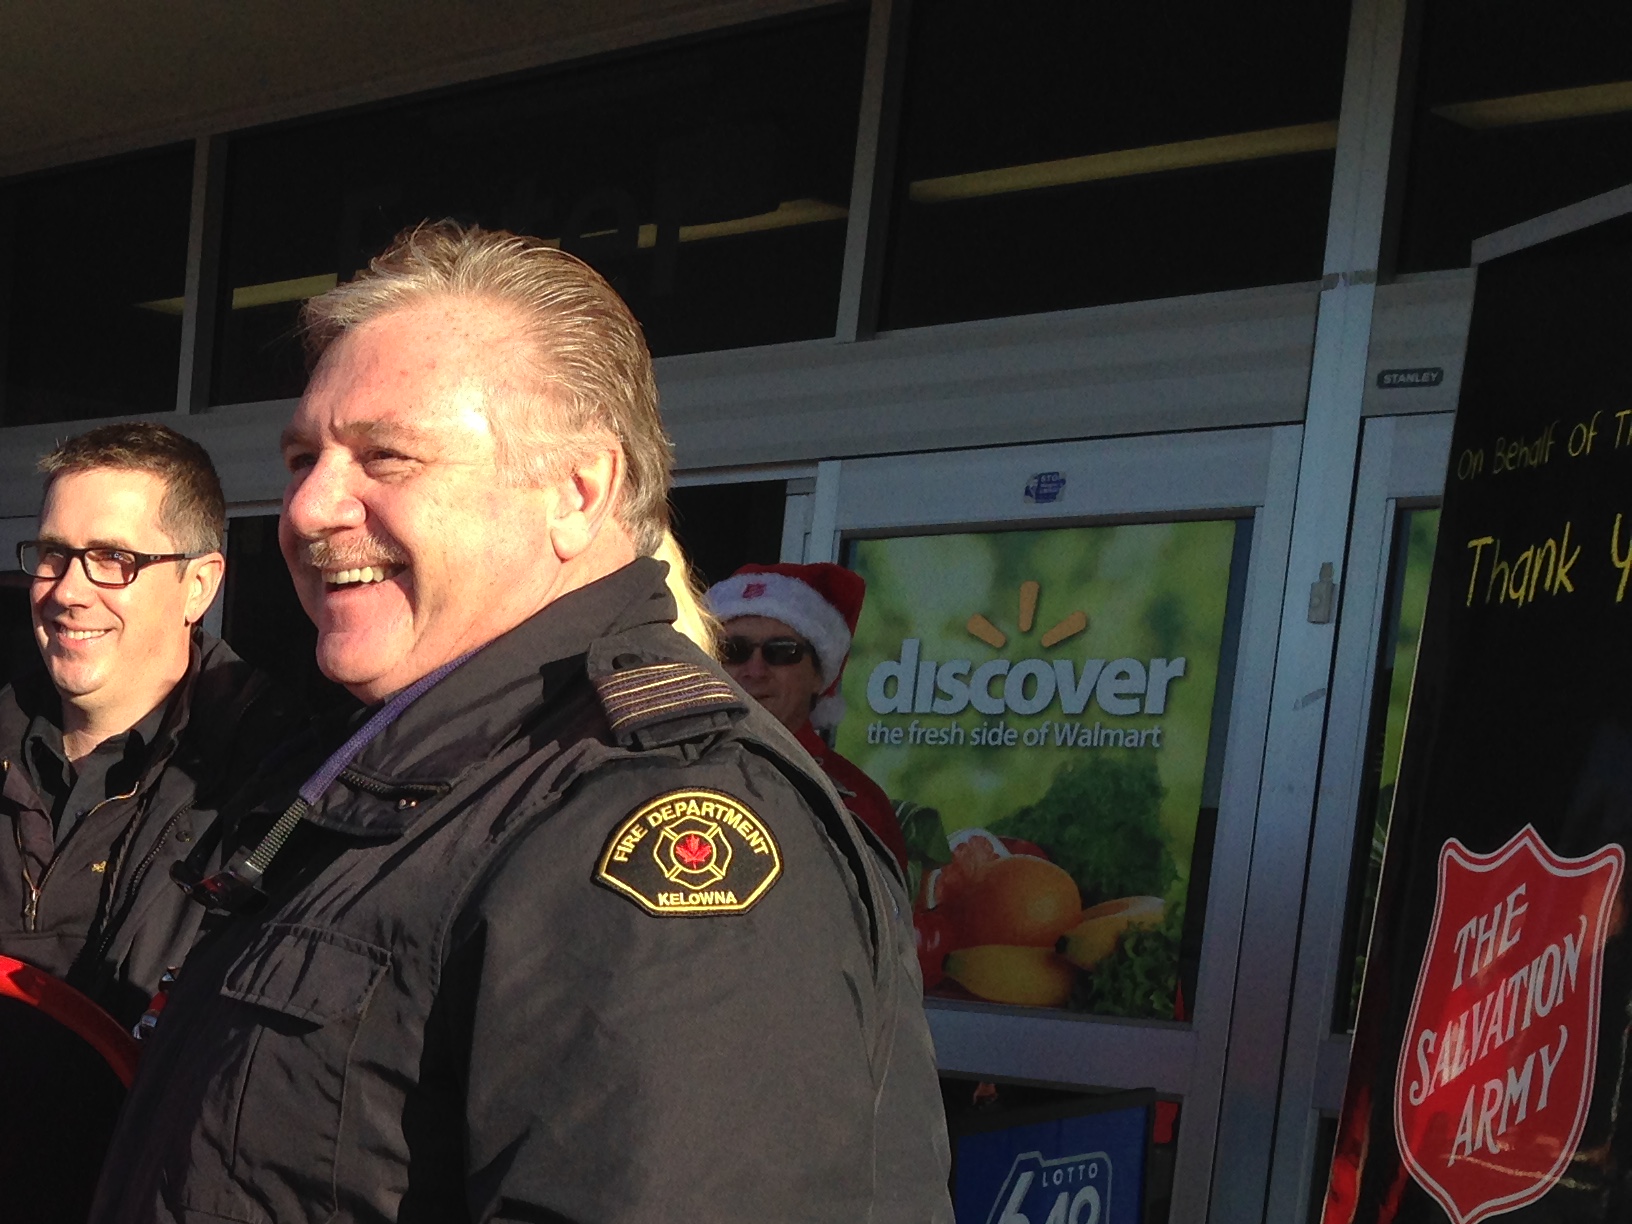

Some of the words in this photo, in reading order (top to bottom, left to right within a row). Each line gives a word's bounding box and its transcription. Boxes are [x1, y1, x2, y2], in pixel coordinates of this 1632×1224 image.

[1383, 371, 1439, 384] STANLEY
[1467, 520, 1582, 609] Thank
[866, 638, 1186, 716] discover
[867, 720, 903, 745] the
[907, 719, 964, 746] fresh
[969, 721, 1018, 747] side
[1022, 720, 1051, 747] of
[1053, 721, 1161, 749] Walmart
[613, 823, 649, 863] FIRE
[647, 799, 770, 857] DEPARTMENT
[657, 890, 738, 906] KELOWNA
[1451, 881, 1528, 991] THE
[1408, 914, 1589, 1106] SALVATION
[1447, 1023, 1569, 1168] ARMY
[1042, 1162, 1099, 1187] LOTTO
